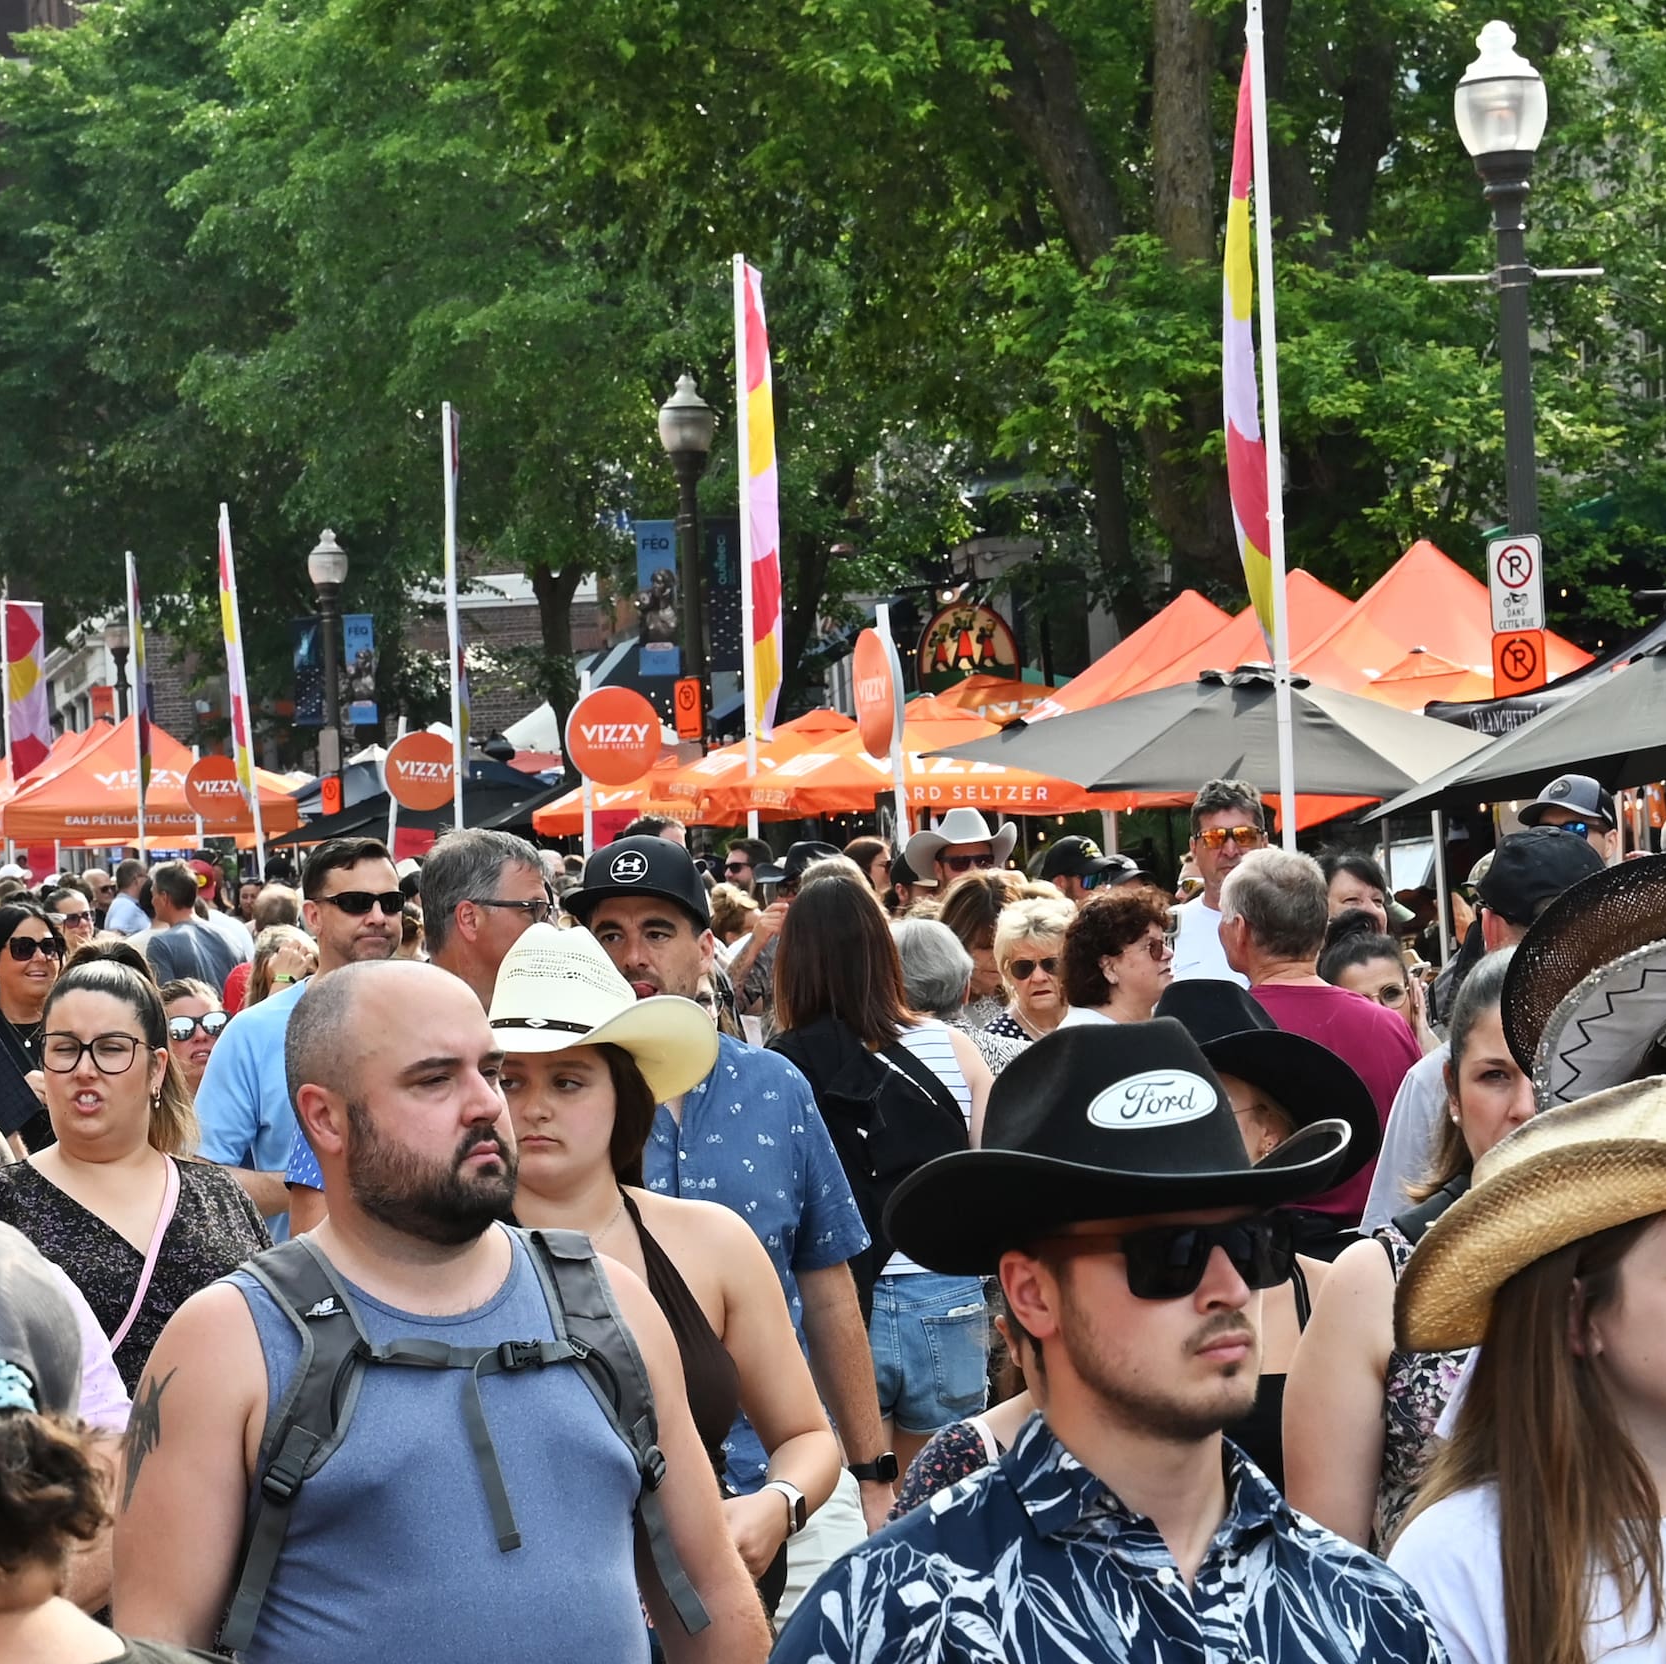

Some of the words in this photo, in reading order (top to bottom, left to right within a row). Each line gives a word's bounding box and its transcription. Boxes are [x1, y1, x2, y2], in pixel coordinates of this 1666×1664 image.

[1507, 607, 1525, 617] DANS
[857, 677, 886, 703] VIZZY
[580, 724, 650, 743] VIZZY
[396, 760, 453, 778] VIZZY
[193, 780, 240, 793] VIZZY
[952, 785, 1048, 801] SELTZER
[64, 815, 89, 826] EAU
[1119, 1080, 1197, 1119] Ford
